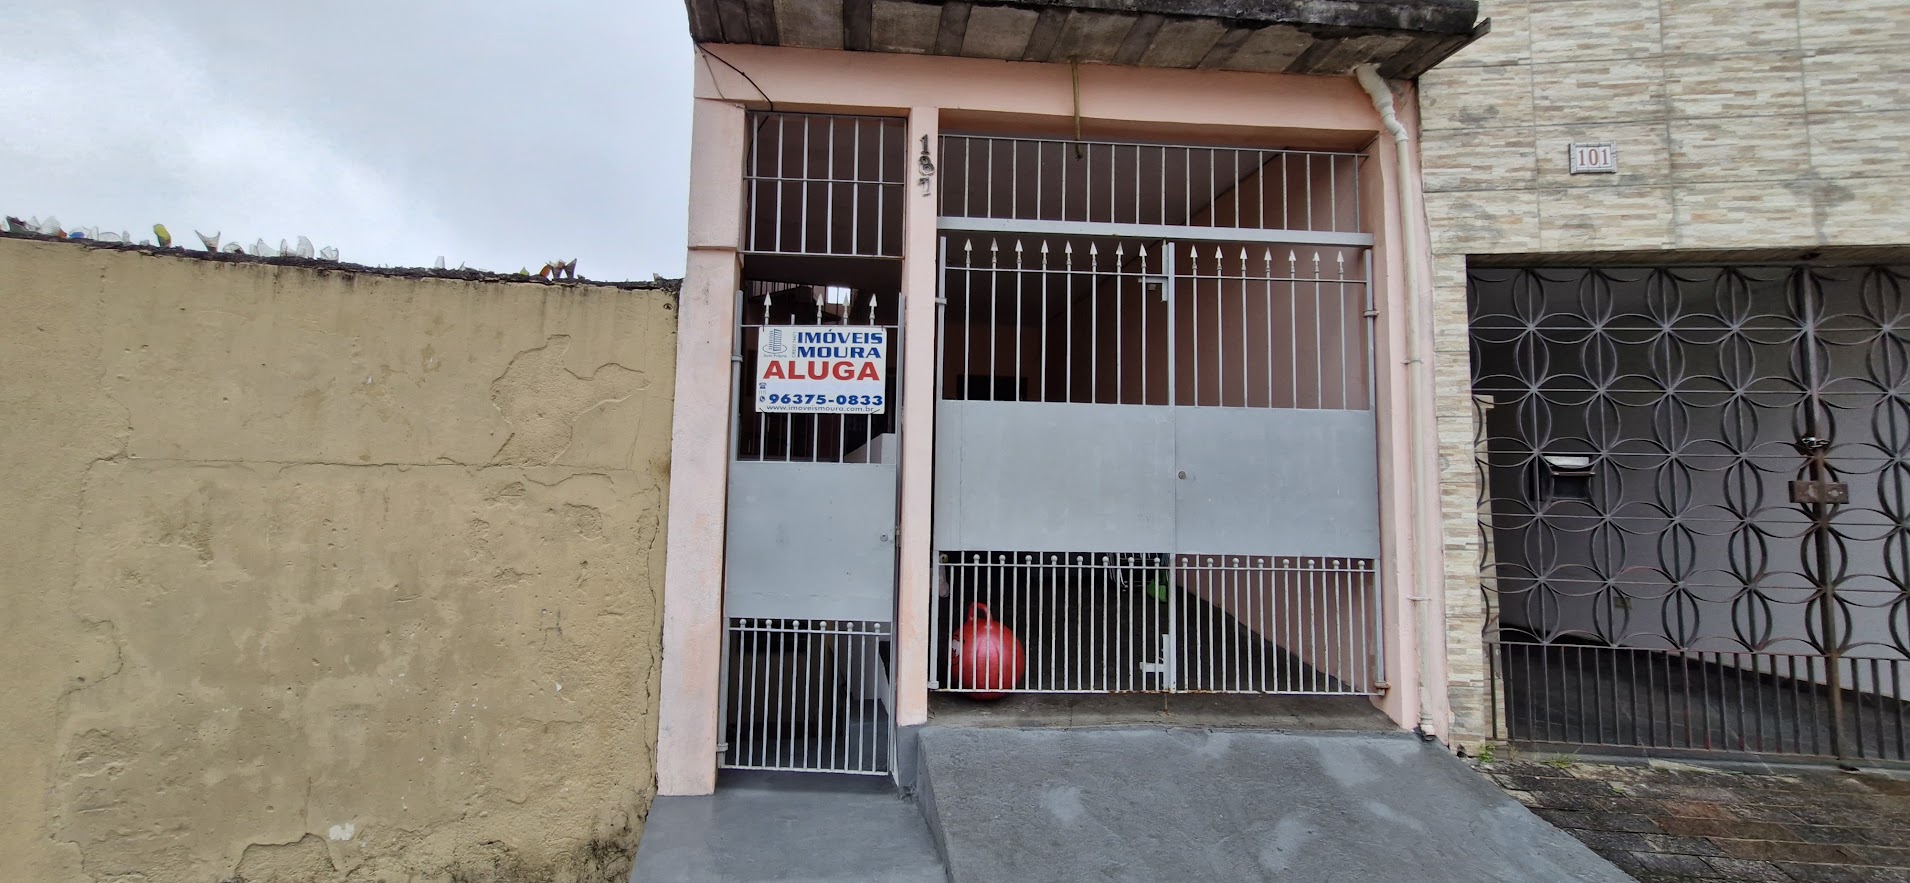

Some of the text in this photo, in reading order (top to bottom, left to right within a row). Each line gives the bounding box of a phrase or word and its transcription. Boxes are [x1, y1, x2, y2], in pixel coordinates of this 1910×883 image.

[1579, 148, 1609, 166] 101
[797, 329, 883, 344] IMÓVEIS
[797, 346, 882, 359] MOURA
[763, 360, 880, 381] ALUGA
[769, 393, 883, 406] 96375-0833
[766, 404, 874, 412] www.imoveismoura.com.br
